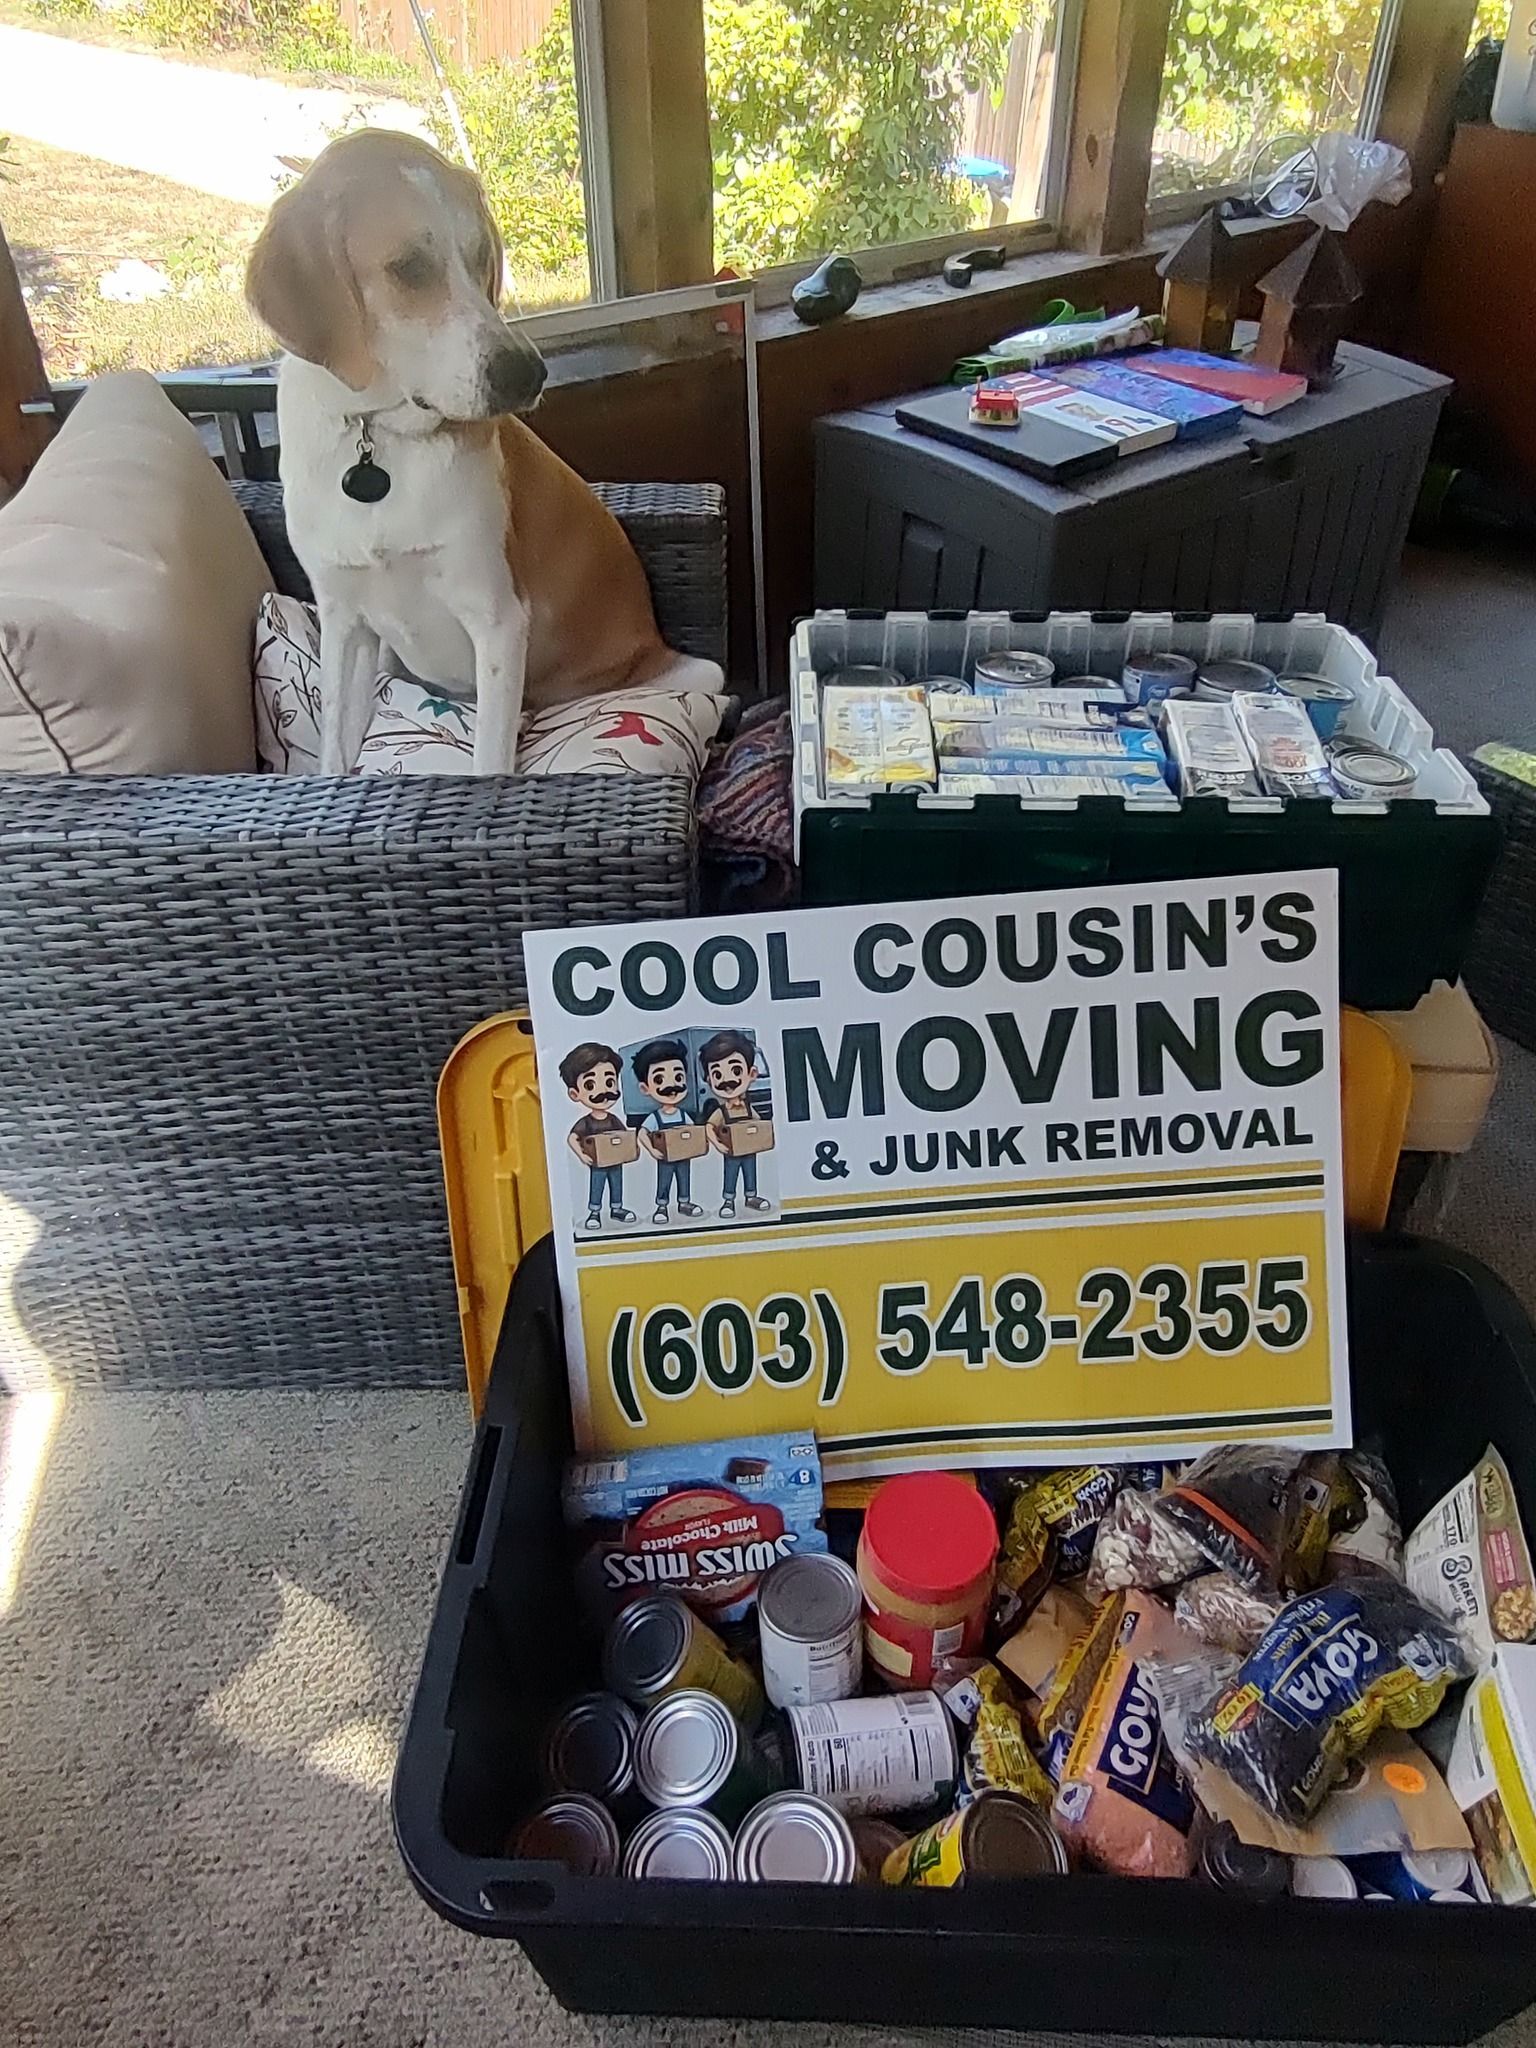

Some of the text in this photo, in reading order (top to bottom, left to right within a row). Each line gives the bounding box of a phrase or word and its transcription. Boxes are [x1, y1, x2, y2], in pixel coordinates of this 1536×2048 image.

[552, 891, 1317, 1017] COOL COUSIN'S
[781, 989, 1324, 1123] MOVING
[811, 1106, 1314, 1181] & JUNK REMOVAL
[609, 1258, 1308, 1424] (603) 548-2355
[640, 1515, 758, 1551] Milk Chocolate
[1109, 1663, 1164, 1777] GOYA
[1288, 1627, 1379, 1711] GOYA
